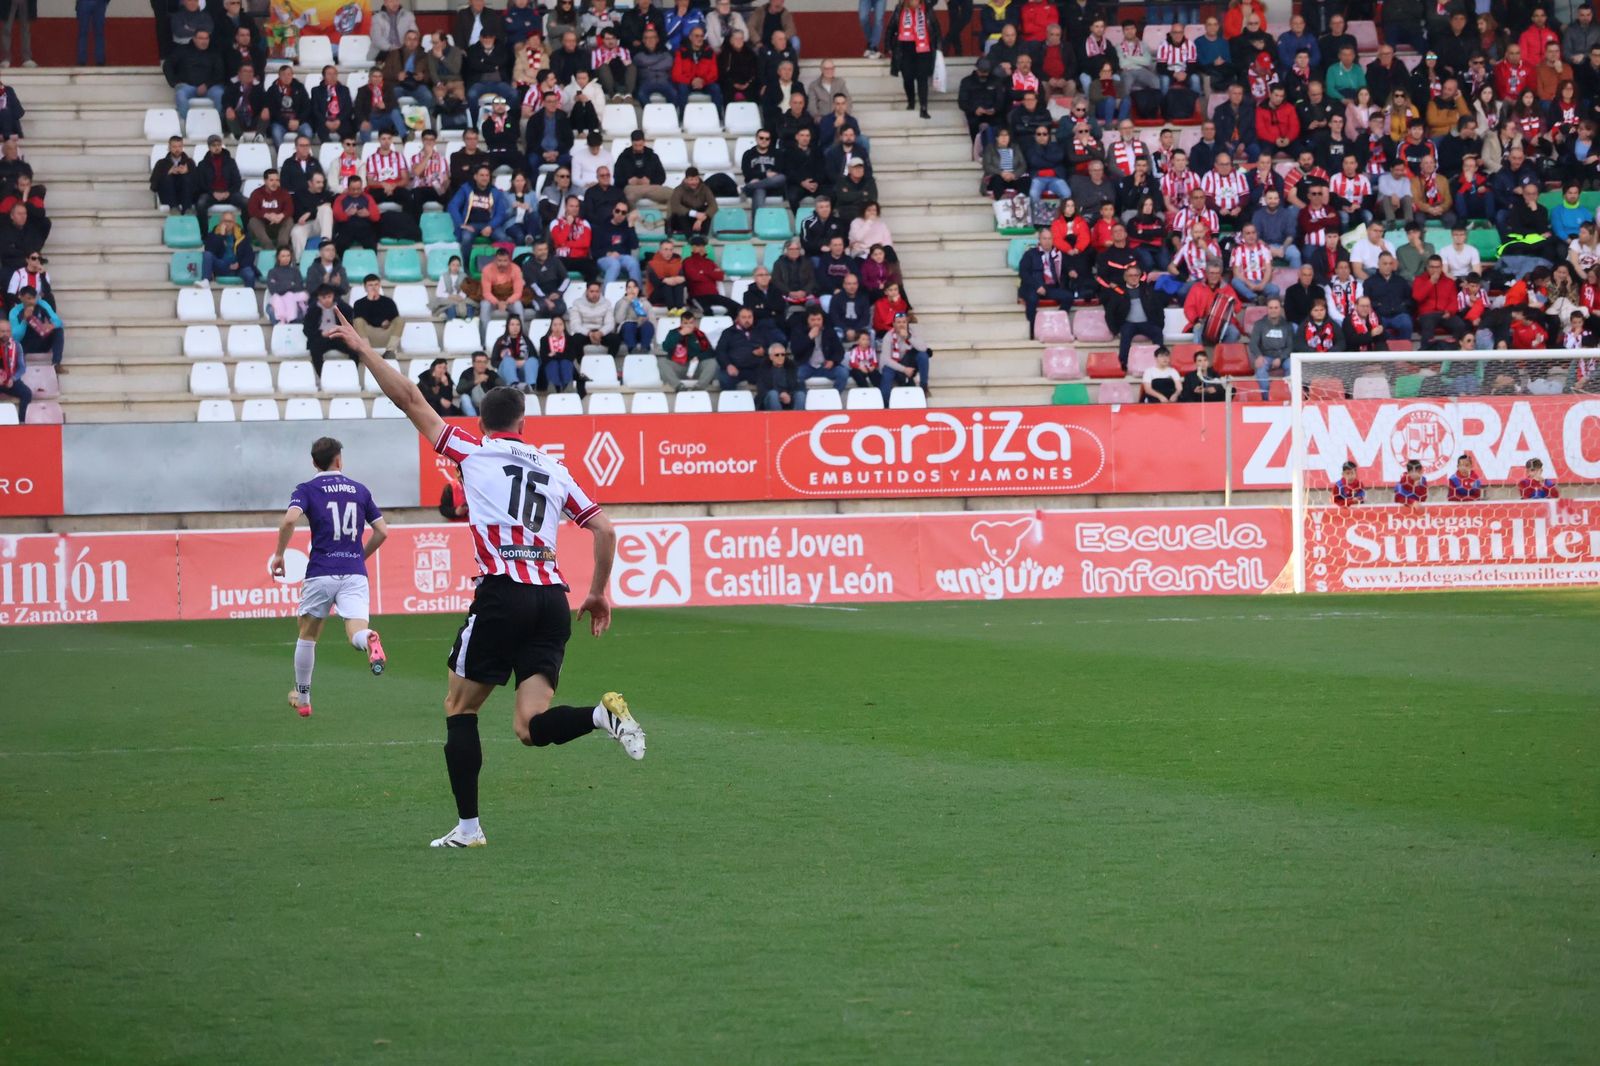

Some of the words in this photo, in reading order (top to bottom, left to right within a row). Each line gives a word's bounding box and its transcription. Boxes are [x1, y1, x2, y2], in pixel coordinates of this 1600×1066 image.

[658, 440, 706, 458] Grupo
[1242, 401, 1559, 484] ZAMORA
[660, 458, 757, 476] Leomotor
[810, 469, 940, 485] EMBUTIDOS
[950, 469, 960, 482] Y
[968, 467, 1072, 481] JAMONES
[322, 484, 356, 494] TAVARES
[503, 464, 550, 533] 16
[326, 501, 357, 541] 14
[1388, 513, 1483, 533] bodegas
[704, 527, 781, 559] Carné
[787, 527, 863, 557] Joven
[1075, 518, 1267, 552] Escuela
[705, 565, 801, 597] Castilla
[806, 577, 823, 603] y
[829, 563, 893, 594] León
[1081, 557, 1268, 593] infantil
[1348, 567, 1598, 584] www.bodegasdelsumiller.co
[403, 595, 473, 611] Castilla
[0, 612, 9, 624] e
[15, 607, 98, 623] Zamora
[229, 608, 276, 618] castilla
